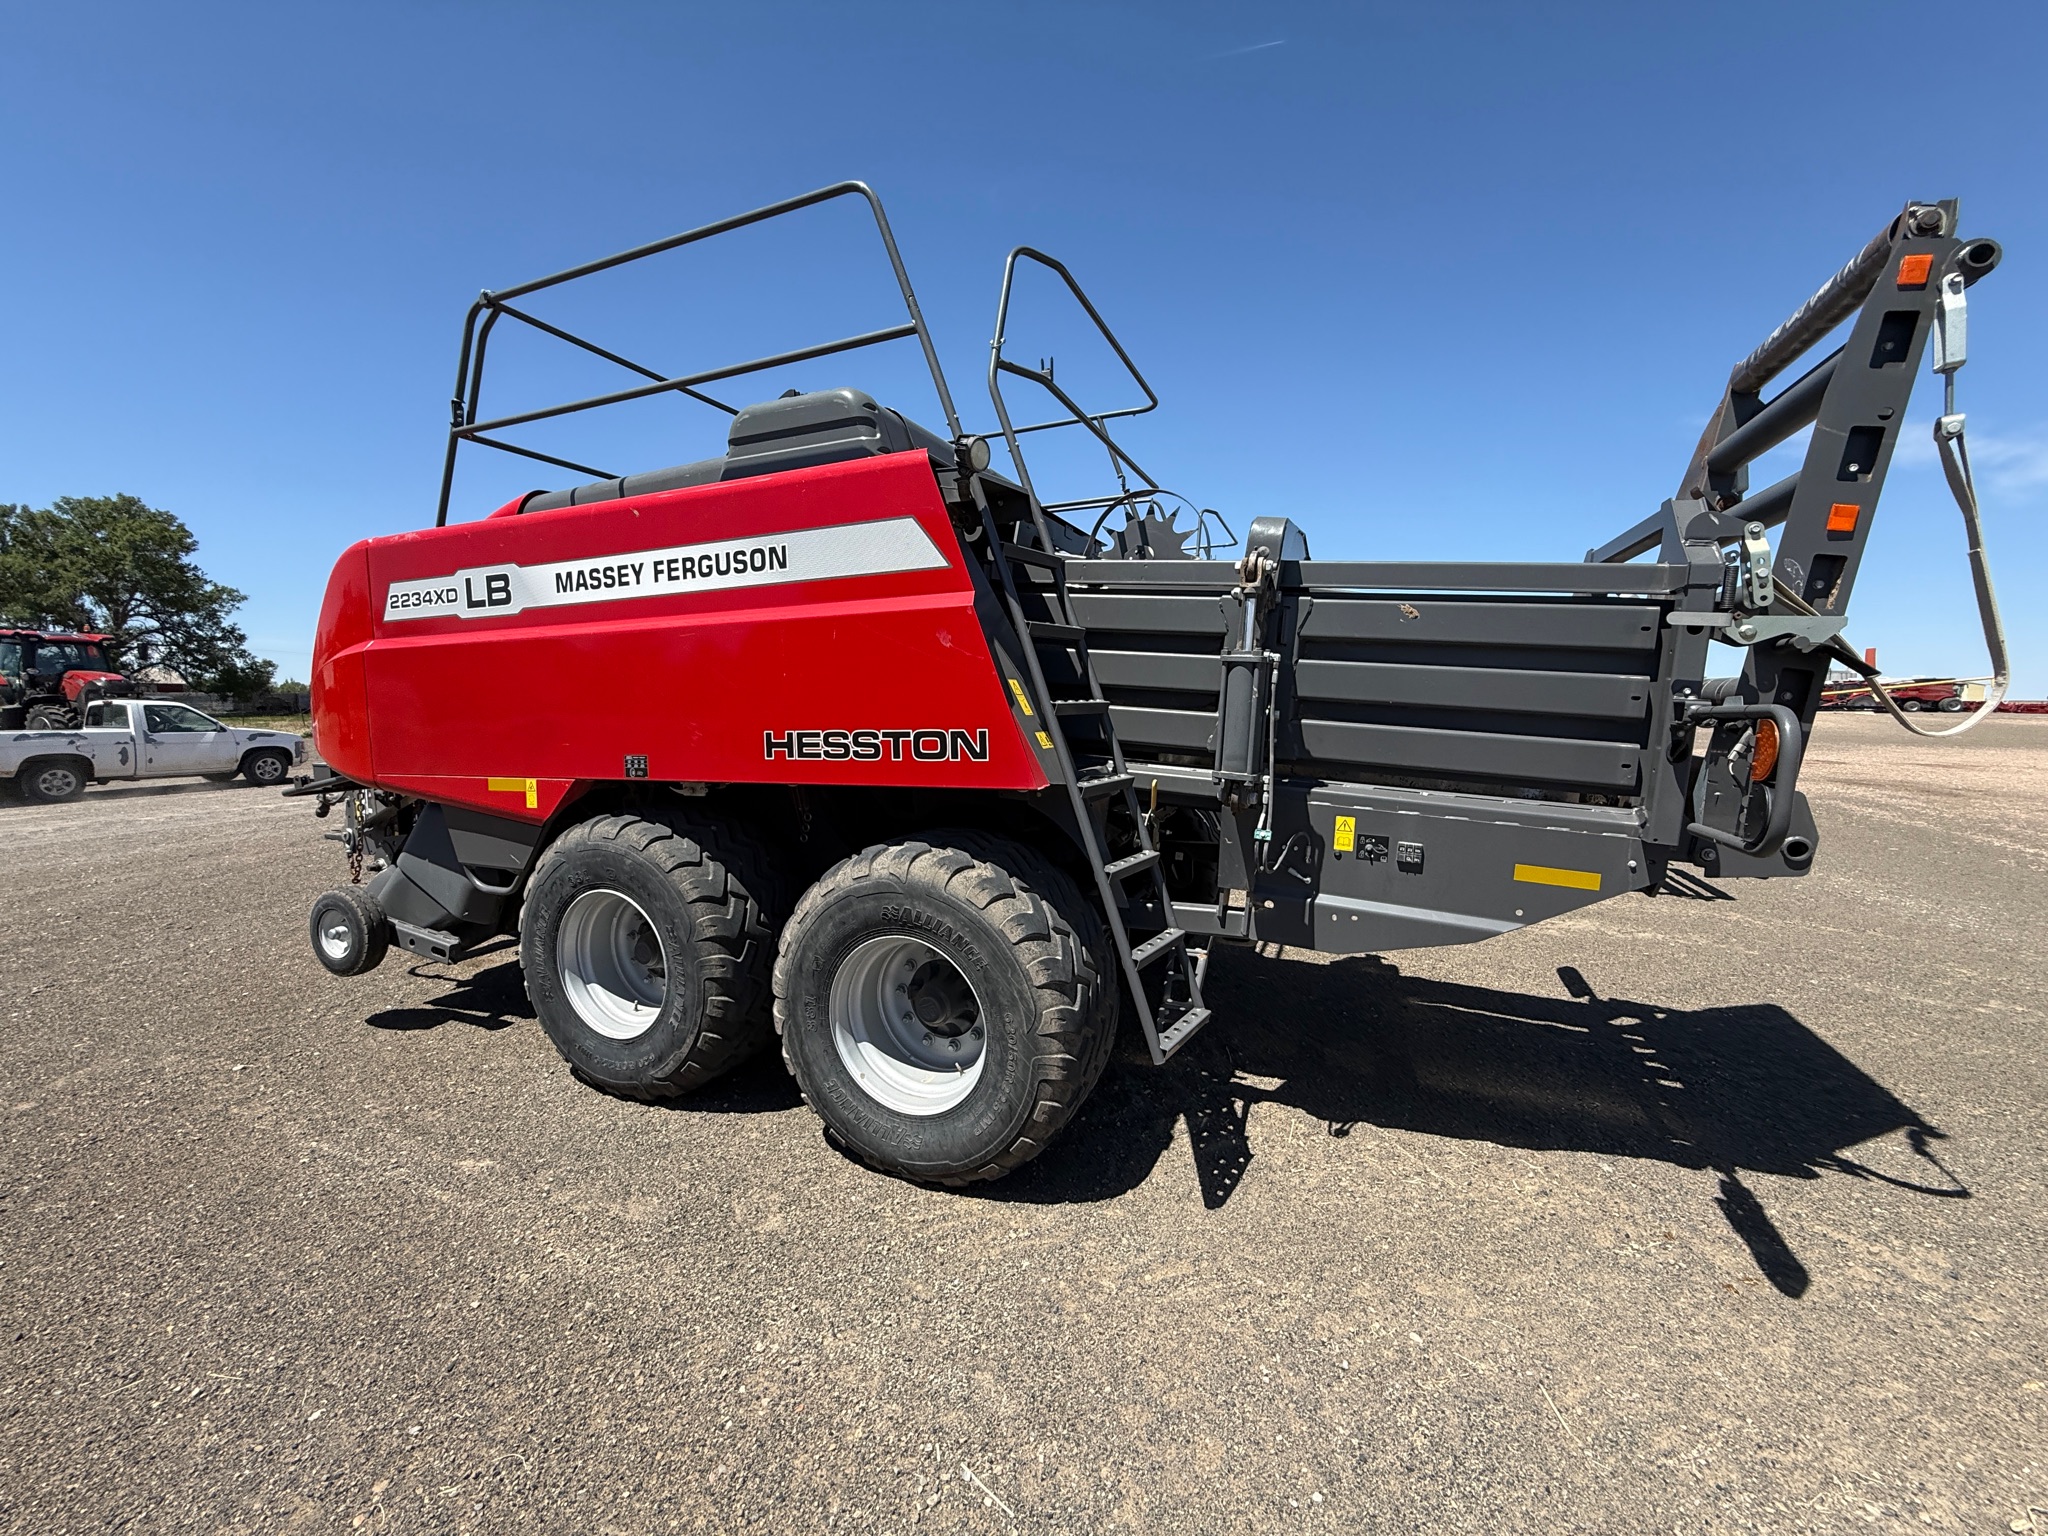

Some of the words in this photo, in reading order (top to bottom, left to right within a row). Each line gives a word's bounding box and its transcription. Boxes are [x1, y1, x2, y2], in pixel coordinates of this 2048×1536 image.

[389, 587, 458, 609] 2234XD
[464, 573, 512, 609] LB
[555, 562, 644, 594] MASSEY
[653, 544, 788, 583] FERGUSON
[764, 729, 989, 761] HESSTON
[899, 905, 989, 972] ALLIANCE
[823, 1079, 907, 1146] ALLIANCE
